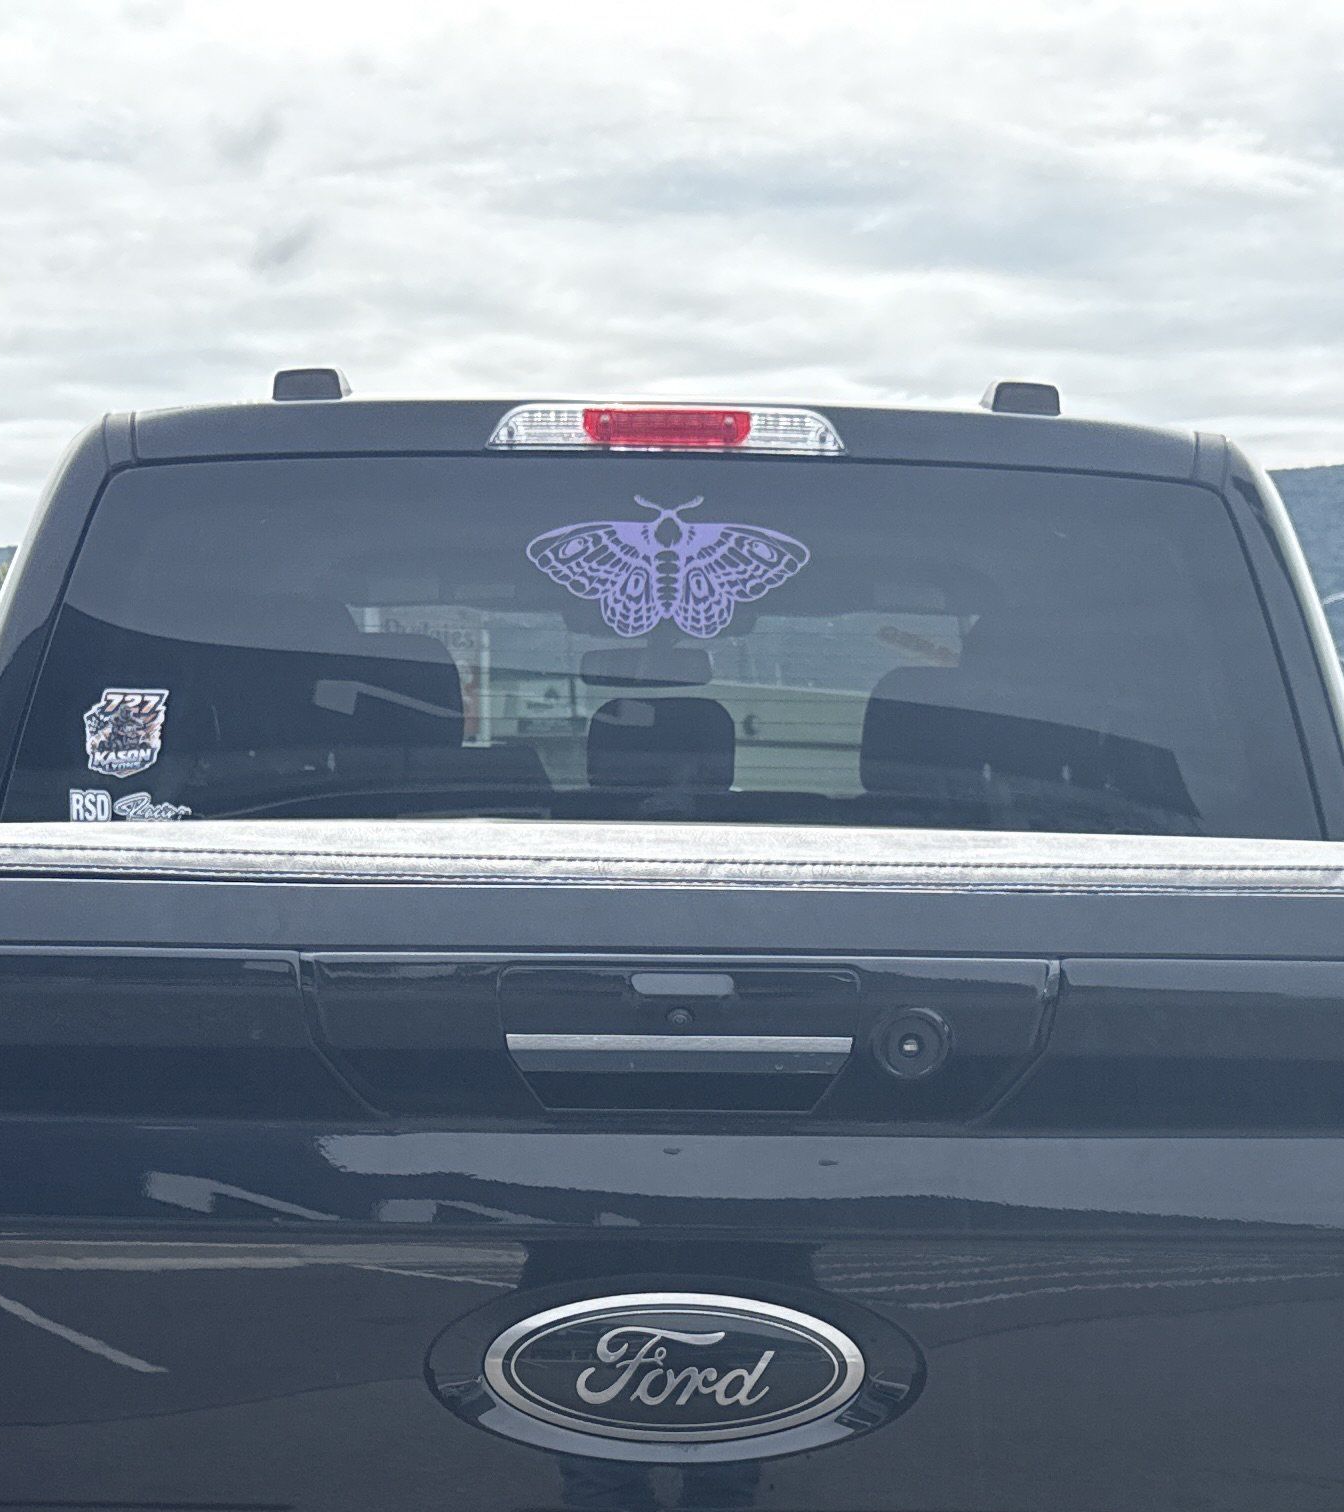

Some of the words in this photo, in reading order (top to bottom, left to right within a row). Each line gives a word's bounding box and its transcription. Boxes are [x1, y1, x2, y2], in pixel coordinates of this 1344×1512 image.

[105, 694, 160, 714] 727
[94, 749, 152, 767] KASON
[71, 793, 110, 821] RSD
[576, 1326, 776, 1406] Ford
